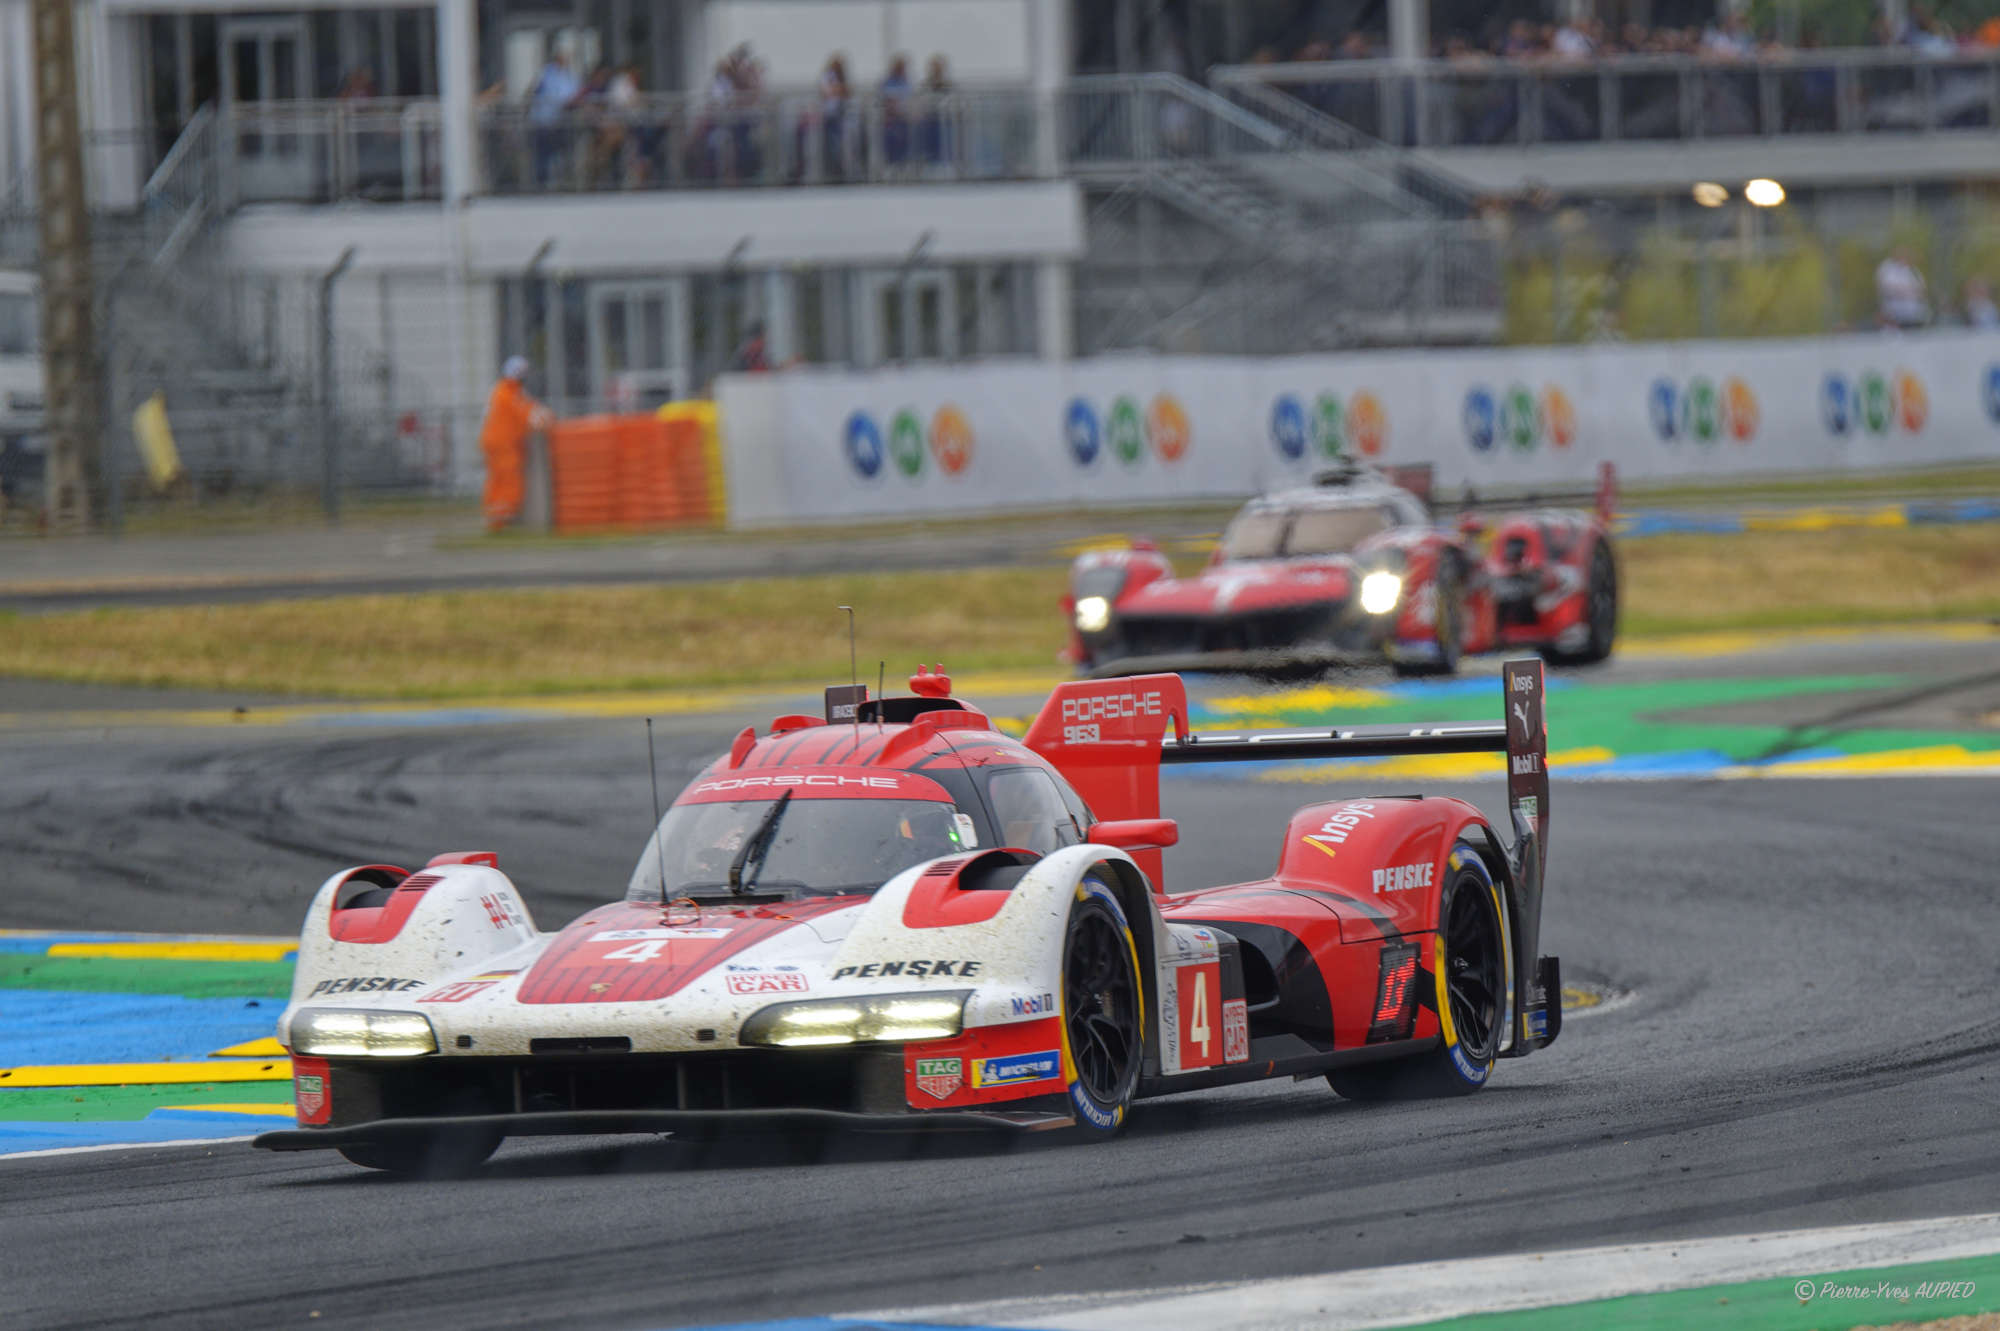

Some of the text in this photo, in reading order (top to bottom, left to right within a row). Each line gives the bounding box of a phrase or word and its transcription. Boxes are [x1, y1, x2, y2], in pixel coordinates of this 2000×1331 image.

[1510, 671, 1534, 695] Ansys
[1062, 691, 1161, 722] PORSCHE
[1063, 723, 1100, 745] 963
[1513, 755, 1532, 776] Mobil
[693, 775, 900, 795] PORSCHE
[1302, 803, 1375, 858] Ansys
[1372, 862, 1435, 894] PENSKE
[601, 939, 670, 963] 4
[831, 960, 983, 981] PENSKE
[307, 976, 427, 1000] PENSKE
[734, 980, 802, 992] CAR
[1012, 994, 1043, 1017] Mobil
[1190, 971, 1211, 1059] 4
[1224, 1024, 1248, 1058] CAR
[921, 1061, 959, 1075] TAG
[918, 1075, 961, 1095] HEUER
